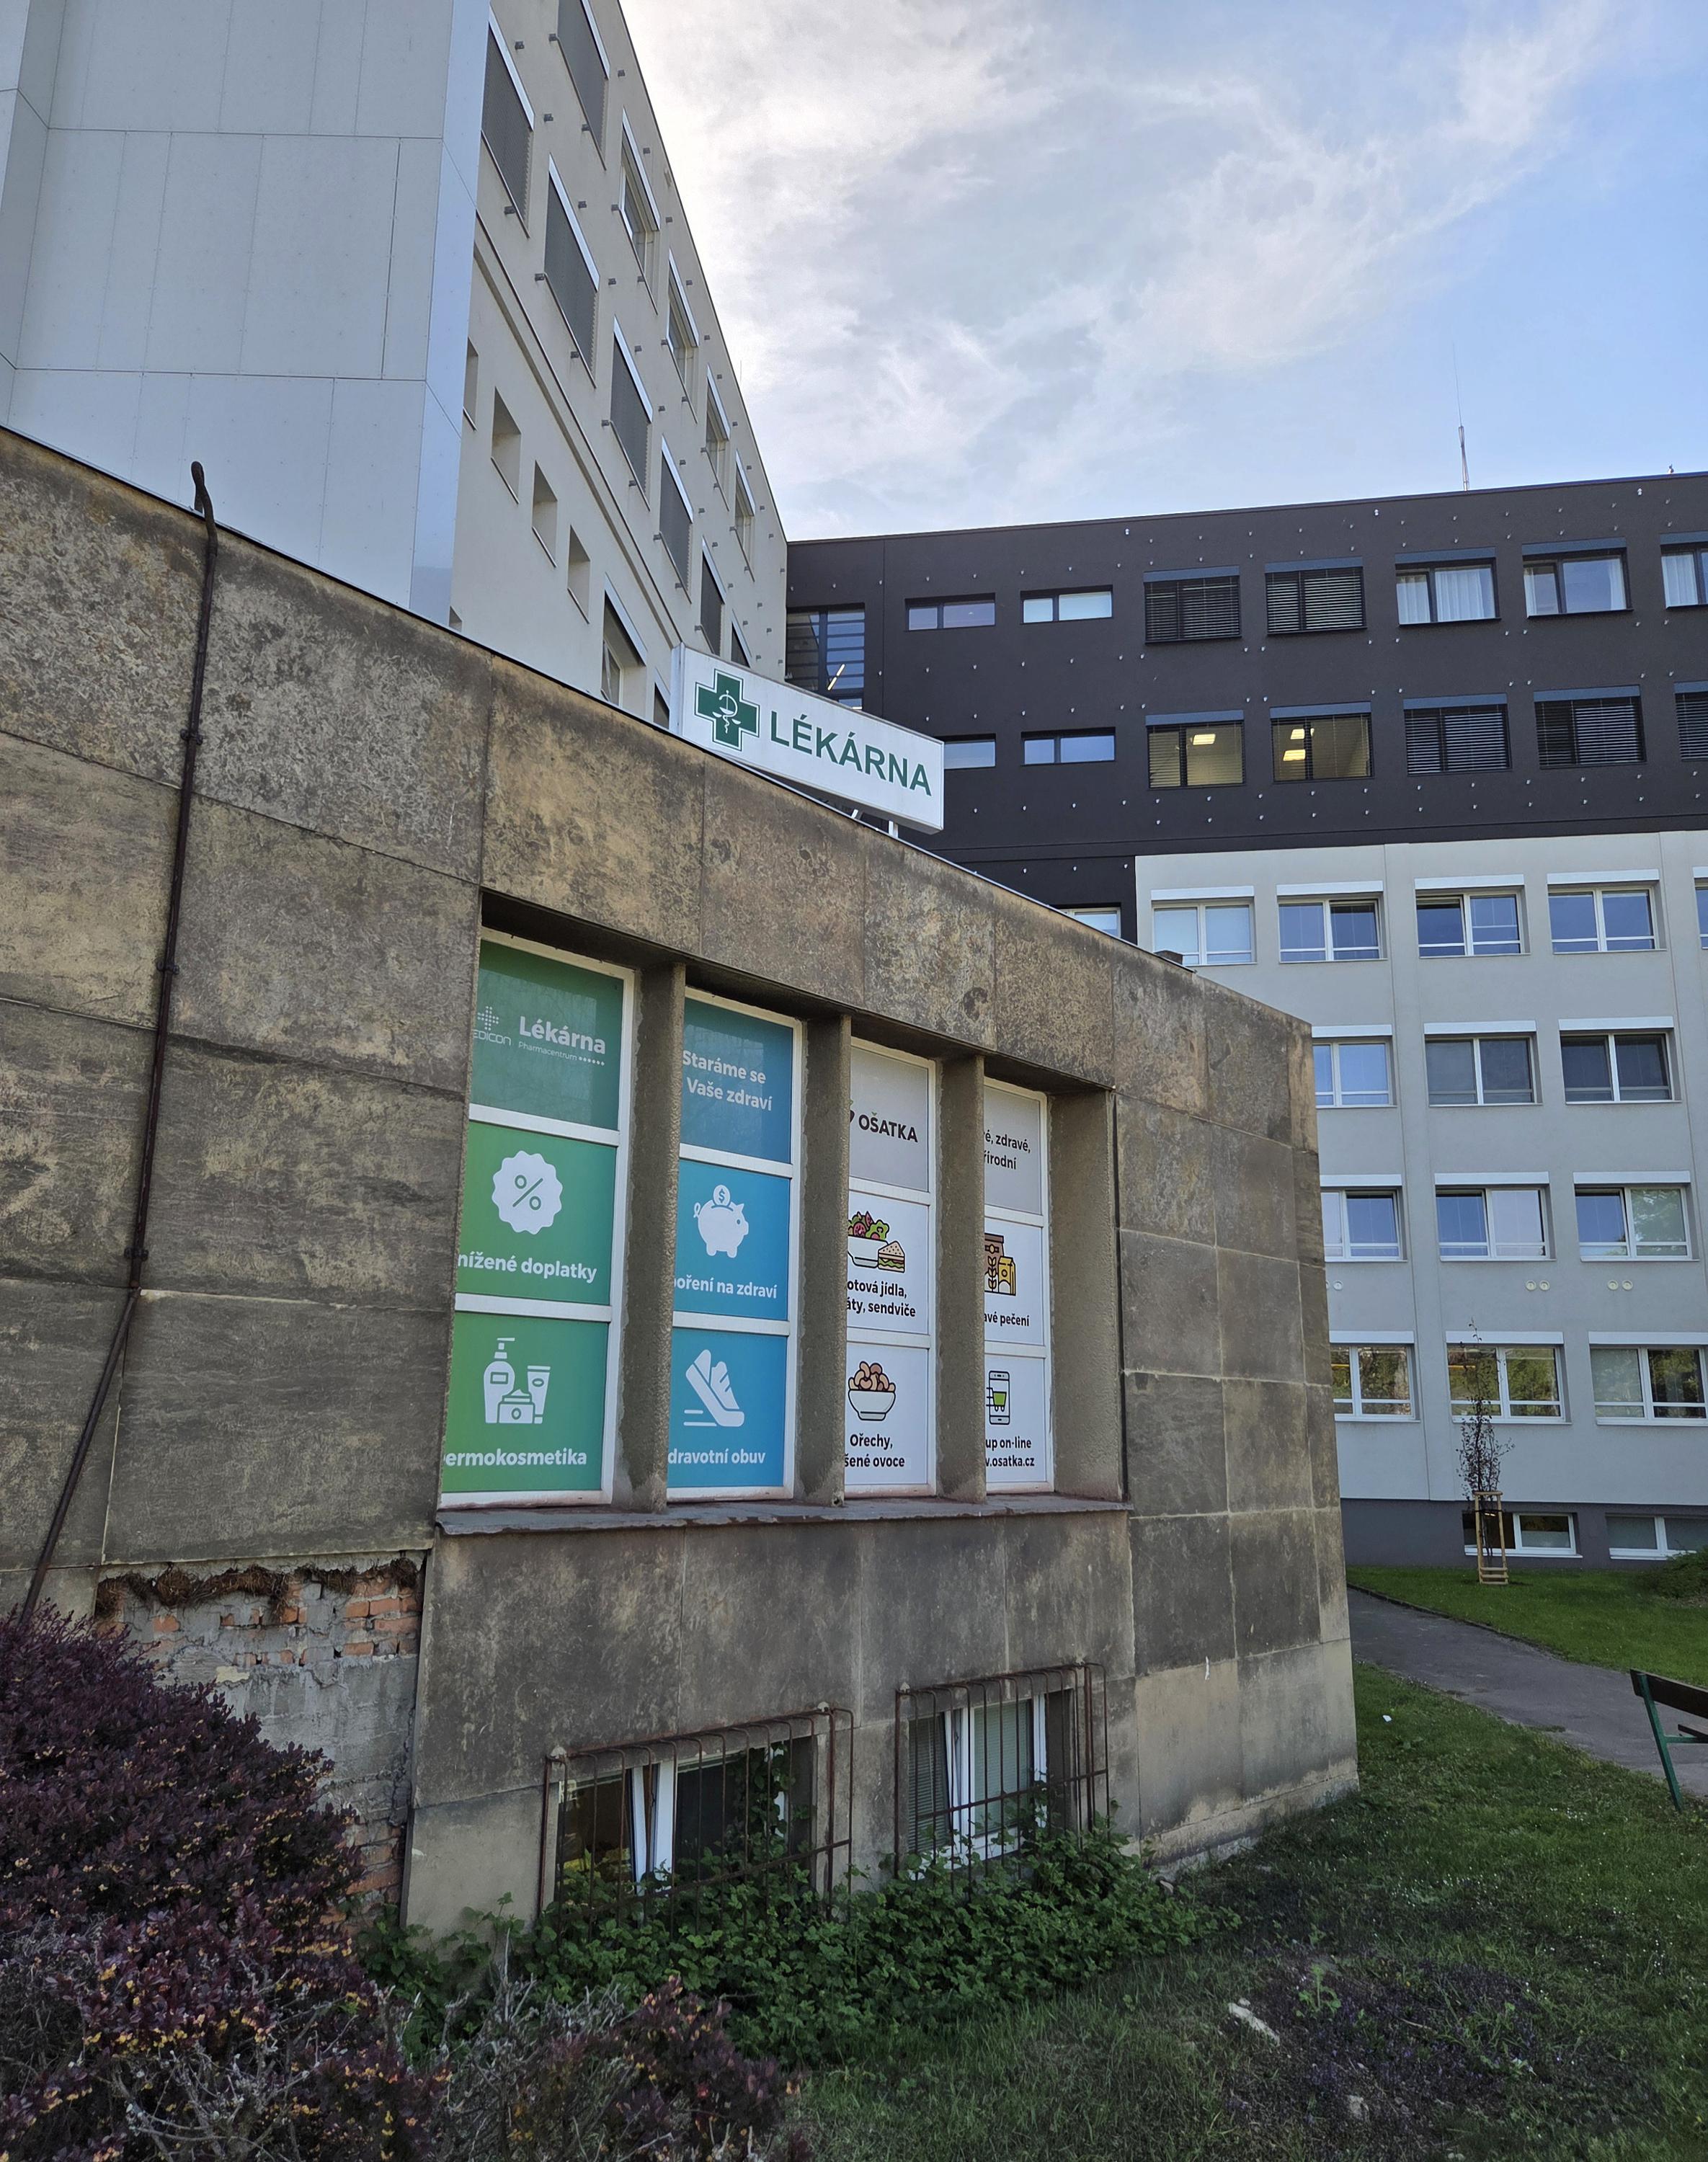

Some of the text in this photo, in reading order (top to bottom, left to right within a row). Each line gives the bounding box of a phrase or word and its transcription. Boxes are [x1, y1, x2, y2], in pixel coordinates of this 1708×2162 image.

[770, 711, 932, 796] LÉKÁRNA
[472, 1028, 512, 1046] EDICON
[520, 1016, 606, 1054] Lékárna
[682, 1050, 766, 1084] Staráme se
[686, 1077, 773, 1111] Vaše zdraví
[858, 1111, 918, 1142] OŠATKA
[995, 1134, 1031, 1153] zdravé,
[458, 1251, 597, 1284] nížené doplatky
[674, 1274, 778, 1299] oření na zdraví
[847, 1279, 907, 1299] otová jídla,
[847, 1297, 916, 1317] áty, sendviče
[984, 1311, 1030, 1327] avé pečení
[850, 1433, 893, 1450] Ořechy,
[1000, 1436, 1032, 1449] on-line
[443, 1447, 587, 1467] ermokosmetika
[667, 1448, 766, 1464] dravotní obuv
[844, 1454, 905, 1467] šené ovoce
